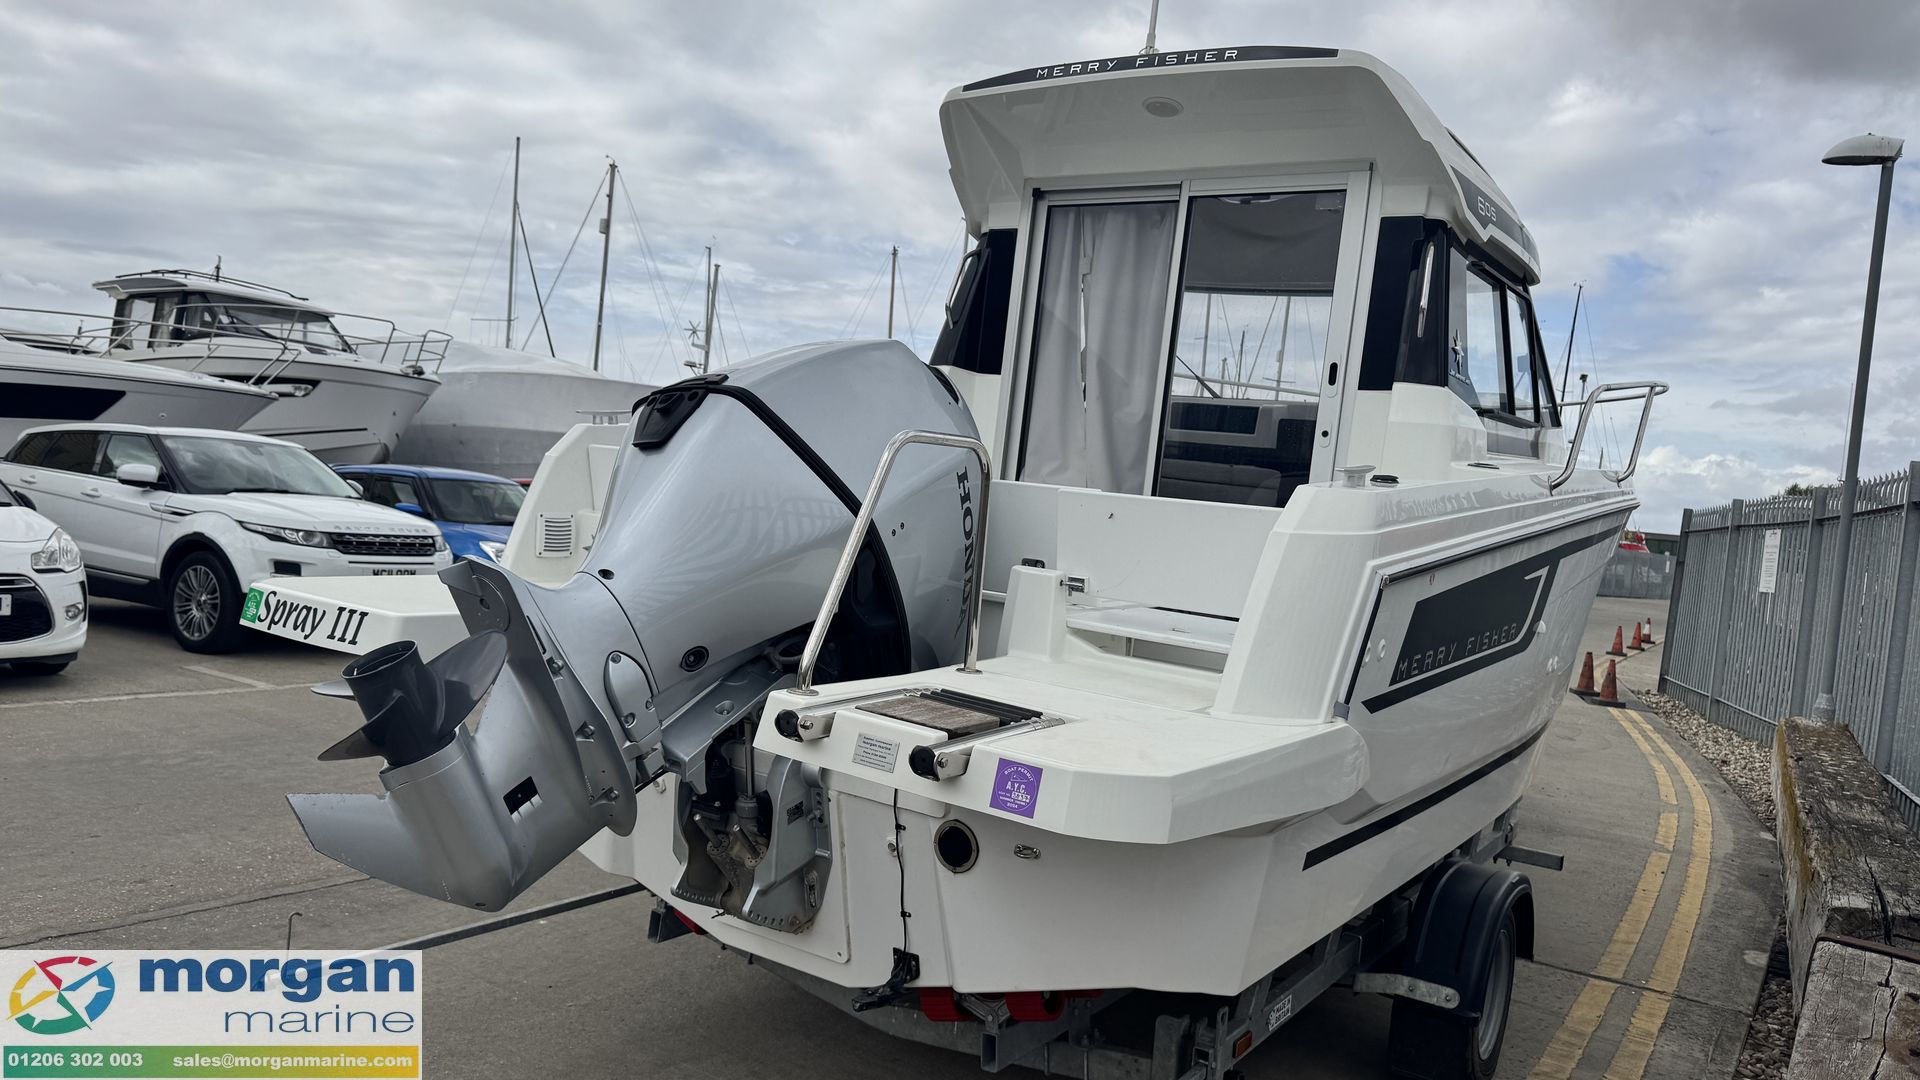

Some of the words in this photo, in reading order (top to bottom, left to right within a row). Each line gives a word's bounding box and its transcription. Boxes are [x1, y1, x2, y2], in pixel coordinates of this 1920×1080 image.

[1036, 60, 1117, 78] MERRY
[1136, 50, 1238, 67] FISHER
[257, 591, 327, 640] Spray
[327, 606, 370, 645] III
[1397, 642, 1457, 680] MERRY
[1466, 623, 1517, 656] FISHER
[1004, 767, 1017, 775] BOAT
[1006, 781, 1027, 794] A.Y.C.
